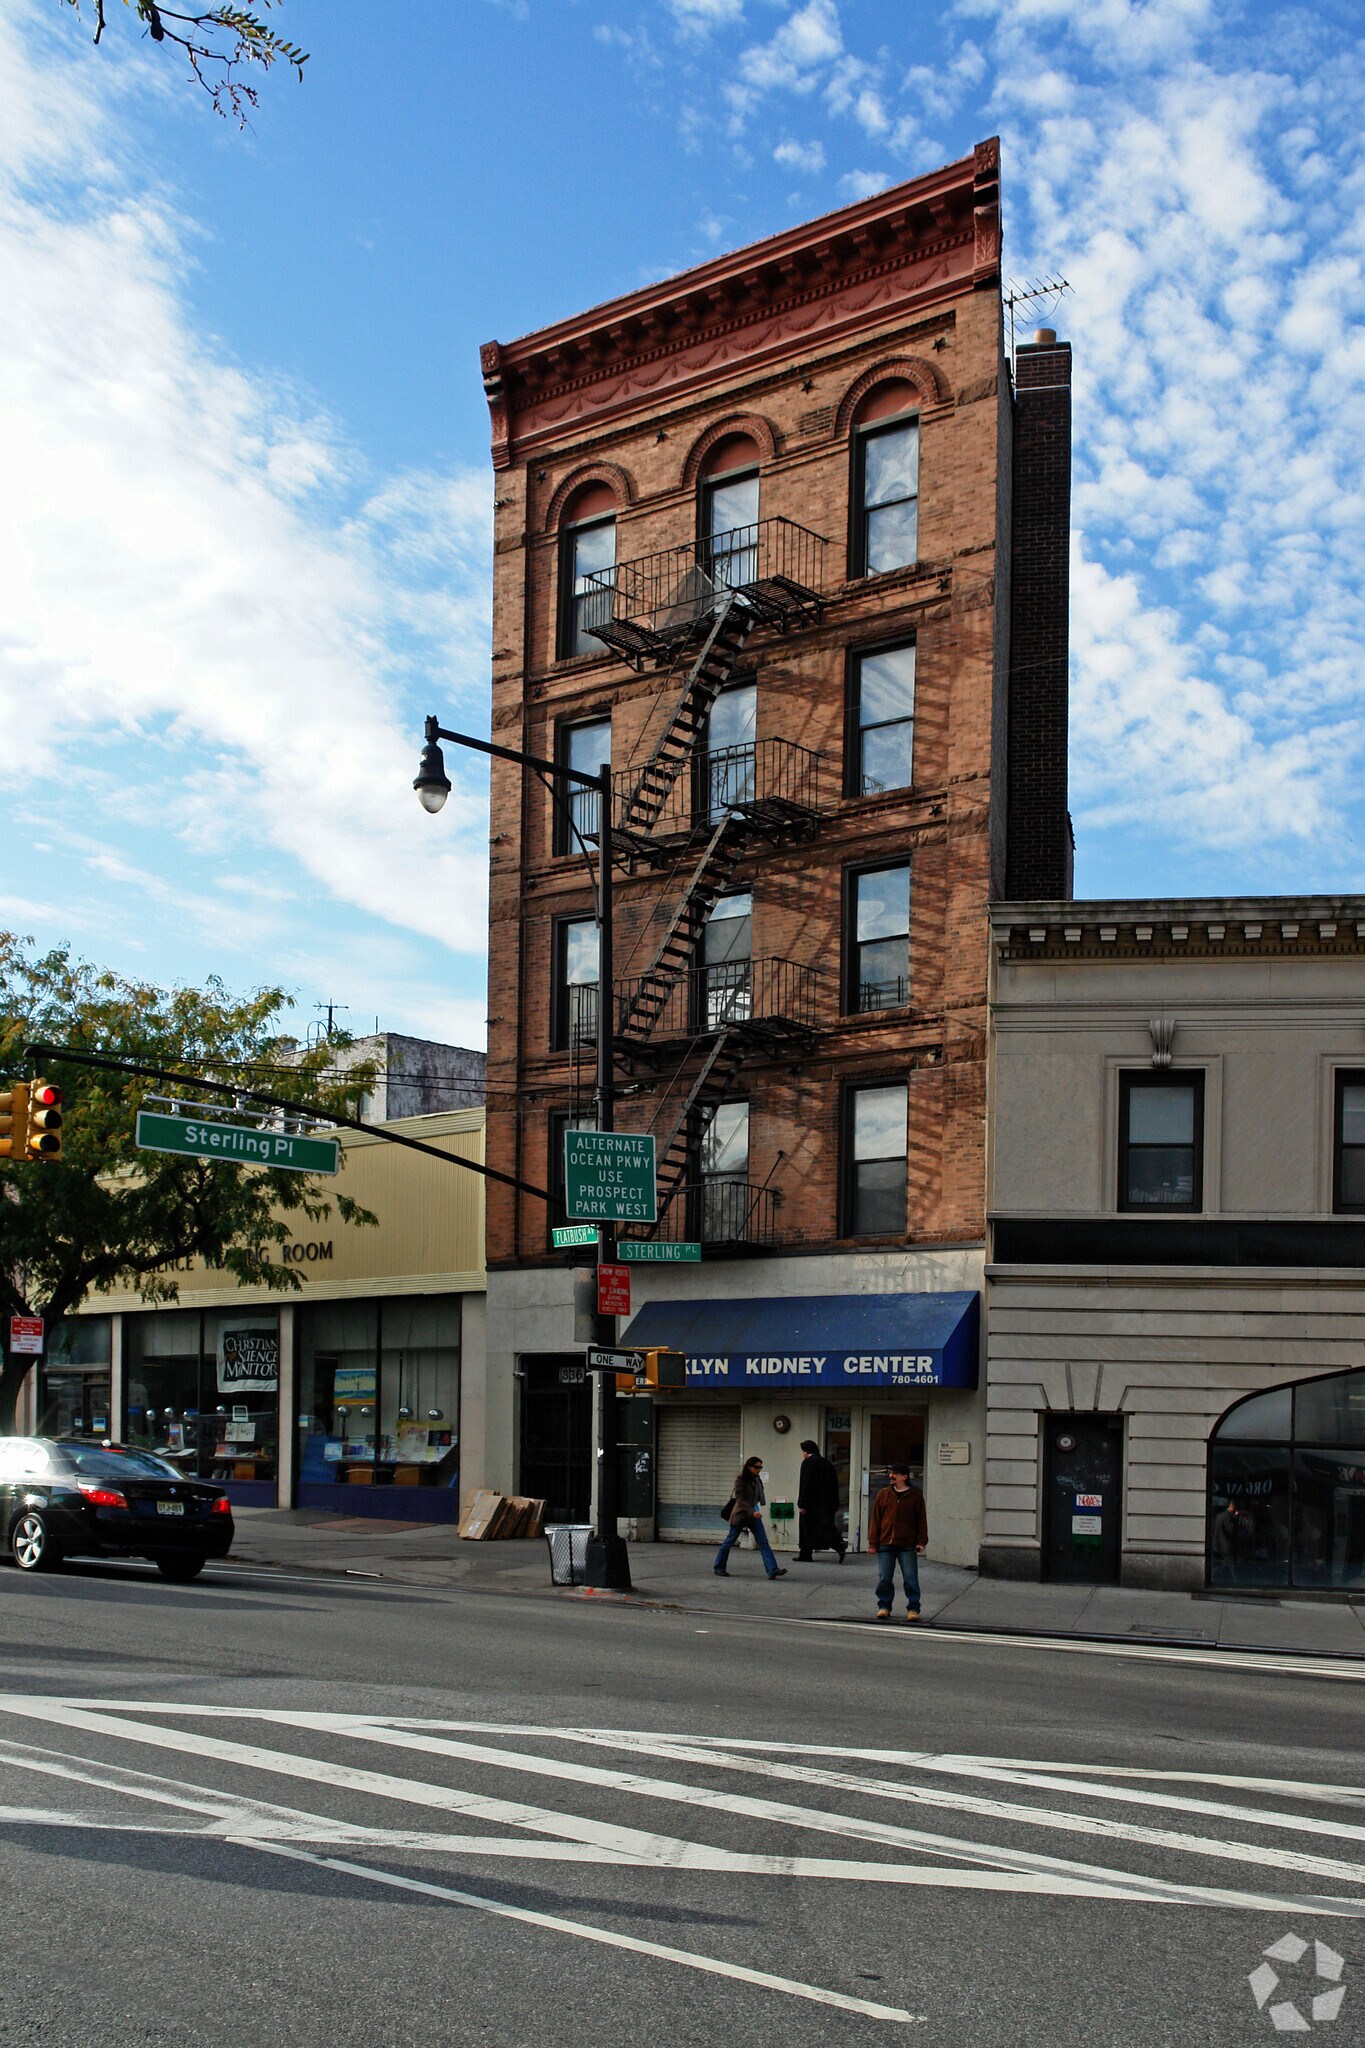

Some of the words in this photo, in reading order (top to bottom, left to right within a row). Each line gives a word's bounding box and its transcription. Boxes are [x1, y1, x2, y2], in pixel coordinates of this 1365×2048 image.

[184, 1125, 271, 1159] Sterling
[274, 1138, 293, 1158] Pl
[576, 1137, 645, 1153] ALTERNATE
[570, 1152, 611, 1167] OCEAN
[616, 1155, 650, 1169] PKWY
[598, 1170, 623, 1183] USE
[579, 1184, 643, 1200] PROSPECT
[575, 1200, 607, 1214] PARK
[616, 1202, 648, 1216] WEST
[556, 1227, 587, 1244] FLATBUSH
[282, 1240, 333, 1264] ROOM
[626, 1244, 681, 1259] STERLING
[685, 1245, 697, 1254] PL
[596, 1354, 614, 1365] ONE
[625, 1358, 643, 1368] WAY
[746, 1357, 827, 1375] KIDNEY
[843, 1356, 933, 1374] CENTER
[891, 1374, 940, 1385] 780-4601
[829, 1416, 850, 1429] 184
